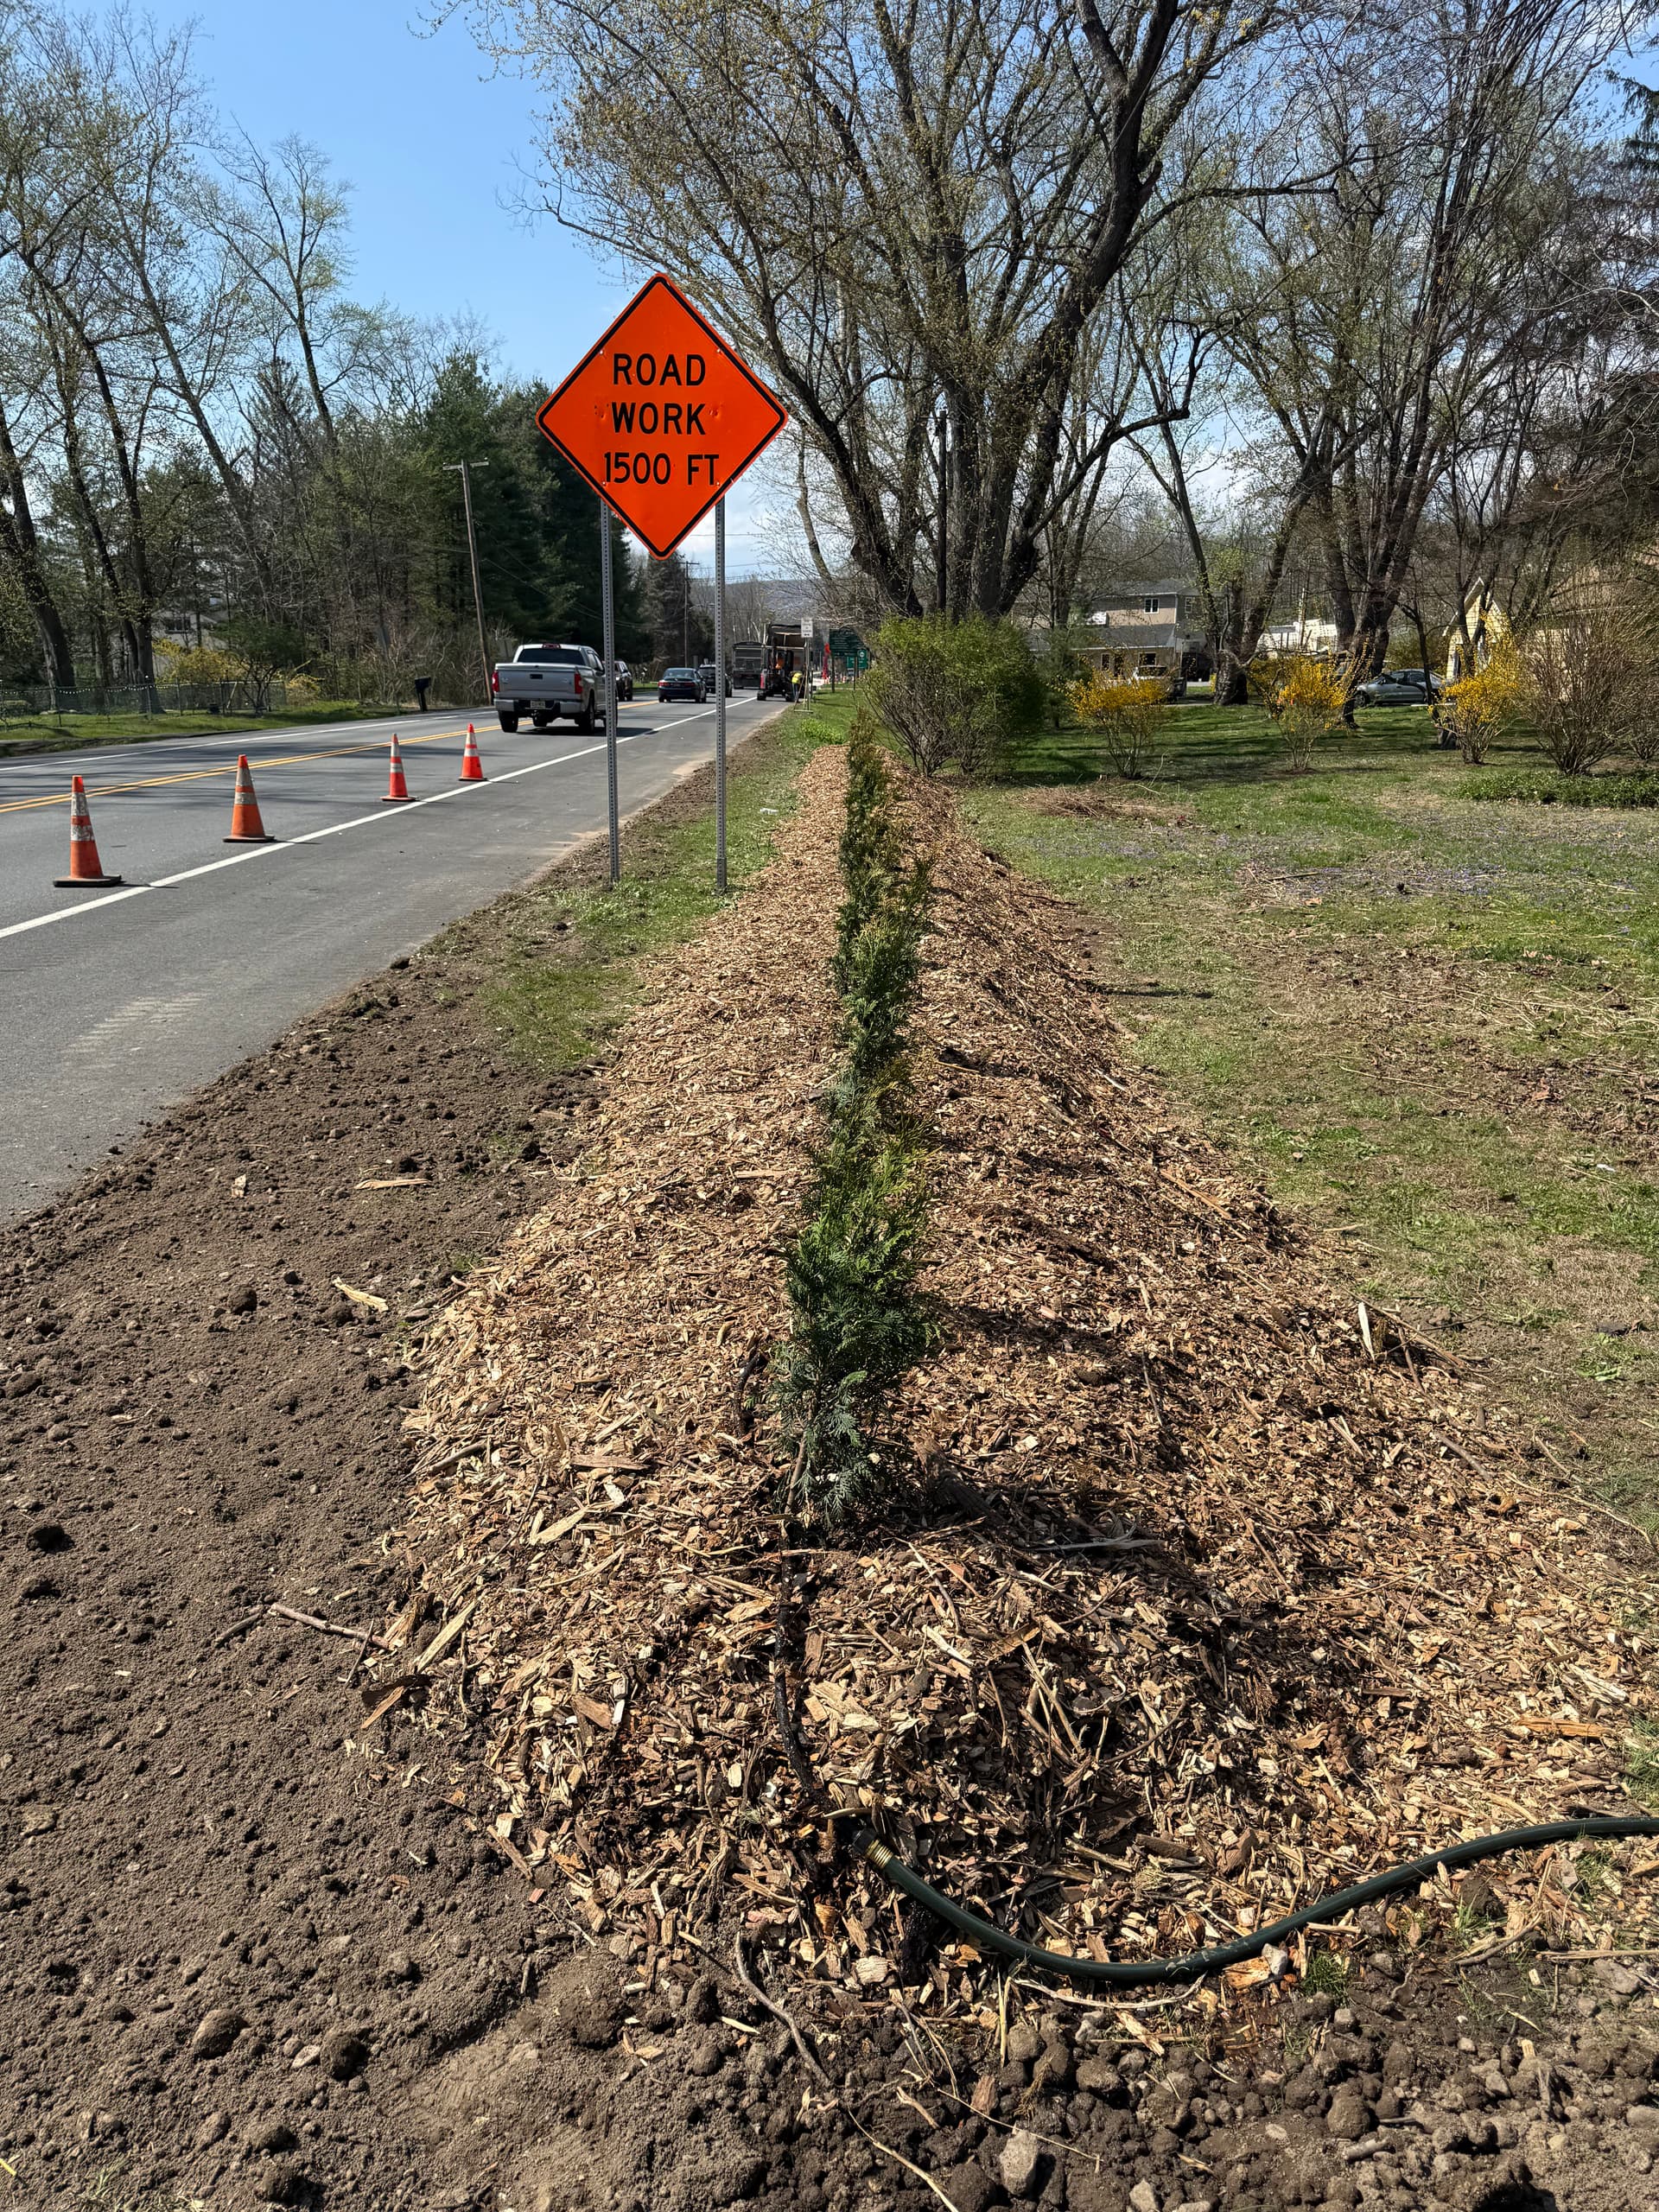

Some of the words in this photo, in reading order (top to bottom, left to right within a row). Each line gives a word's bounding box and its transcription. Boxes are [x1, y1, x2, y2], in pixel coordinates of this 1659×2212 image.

[613, 353, 706, 386] ROAD
[611, 402, 706, 435] WORK
[604, 452, 671, 485] 1500
[687, 454, 720, 486] FT
